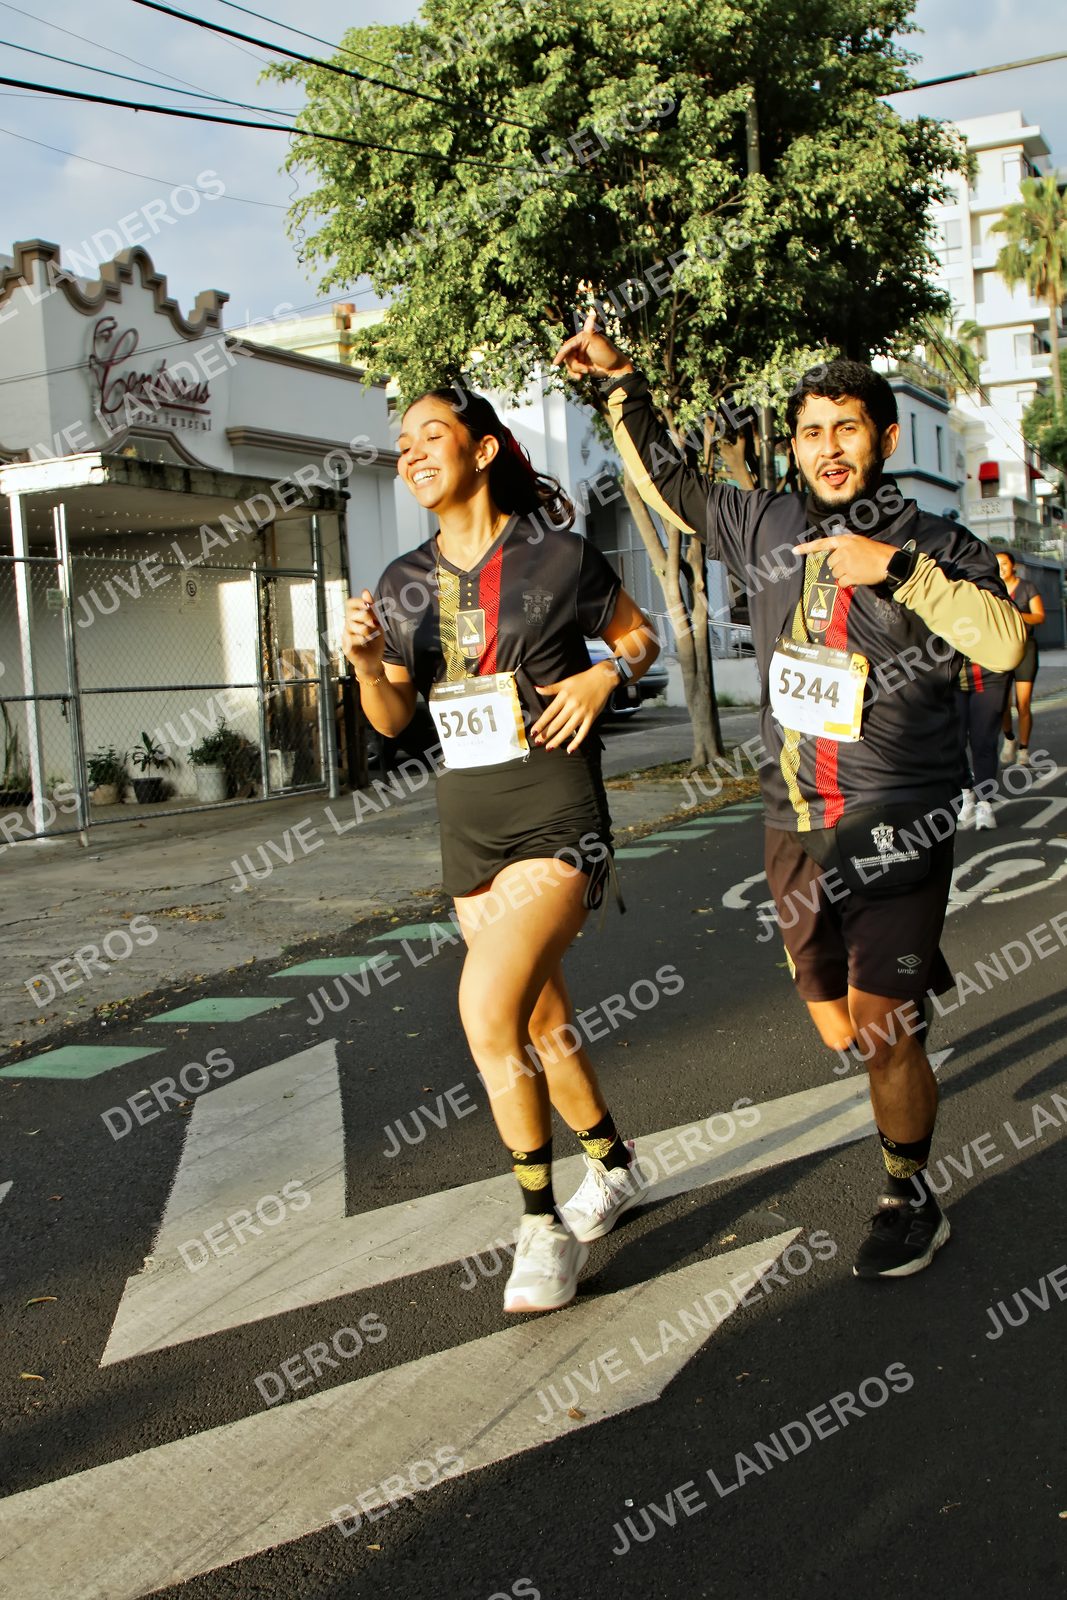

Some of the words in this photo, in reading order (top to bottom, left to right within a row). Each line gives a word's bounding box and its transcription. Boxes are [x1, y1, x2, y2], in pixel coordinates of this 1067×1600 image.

[778, 667, 840, 708] 5244
[439, 705, 497, 739] 5261
[897, 967, 918, 975] umbr
